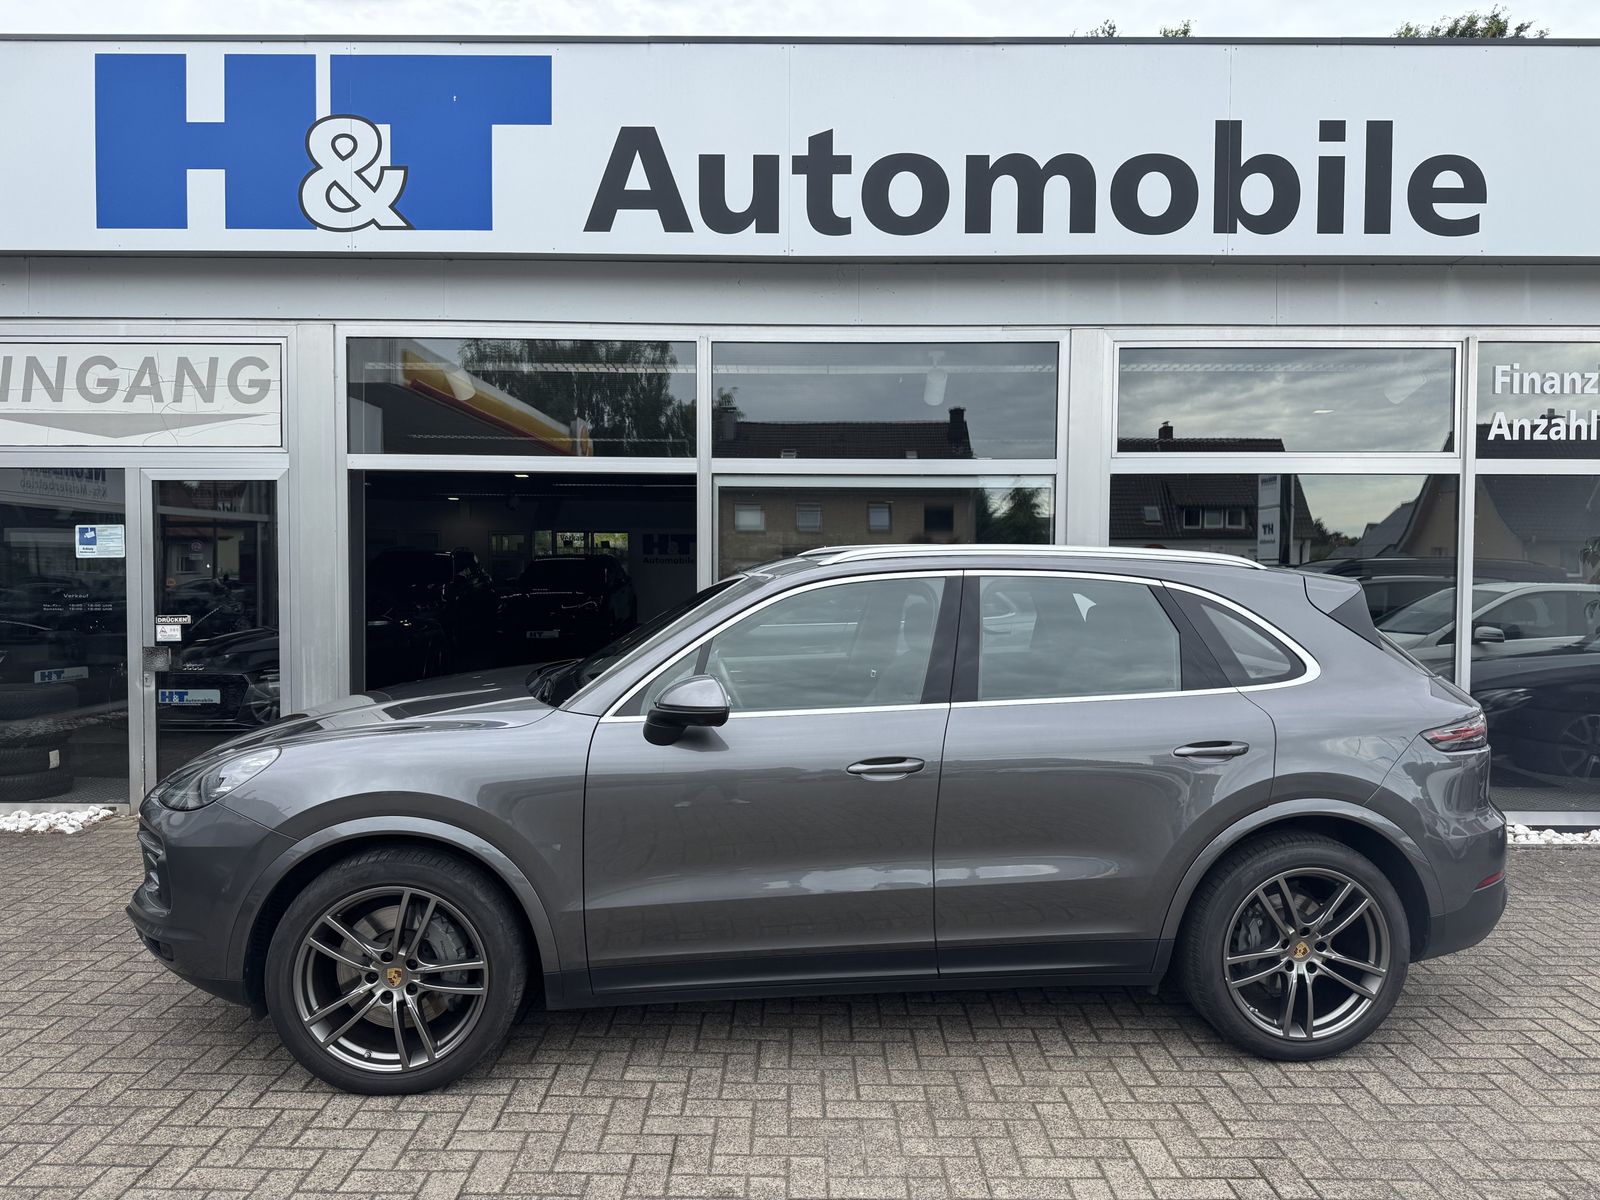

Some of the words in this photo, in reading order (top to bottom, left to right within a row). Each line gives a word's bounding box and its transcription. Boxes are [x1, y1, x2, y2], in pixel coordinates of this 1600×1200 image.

[95, 53, 552, 232] H&T
[583, 119, 1488, 237] Automobile
[0, 355, 272, 404] INGANG
[1487, 409, 1598, 441] Anzahl
[160, 690, 188, 702] H&T
